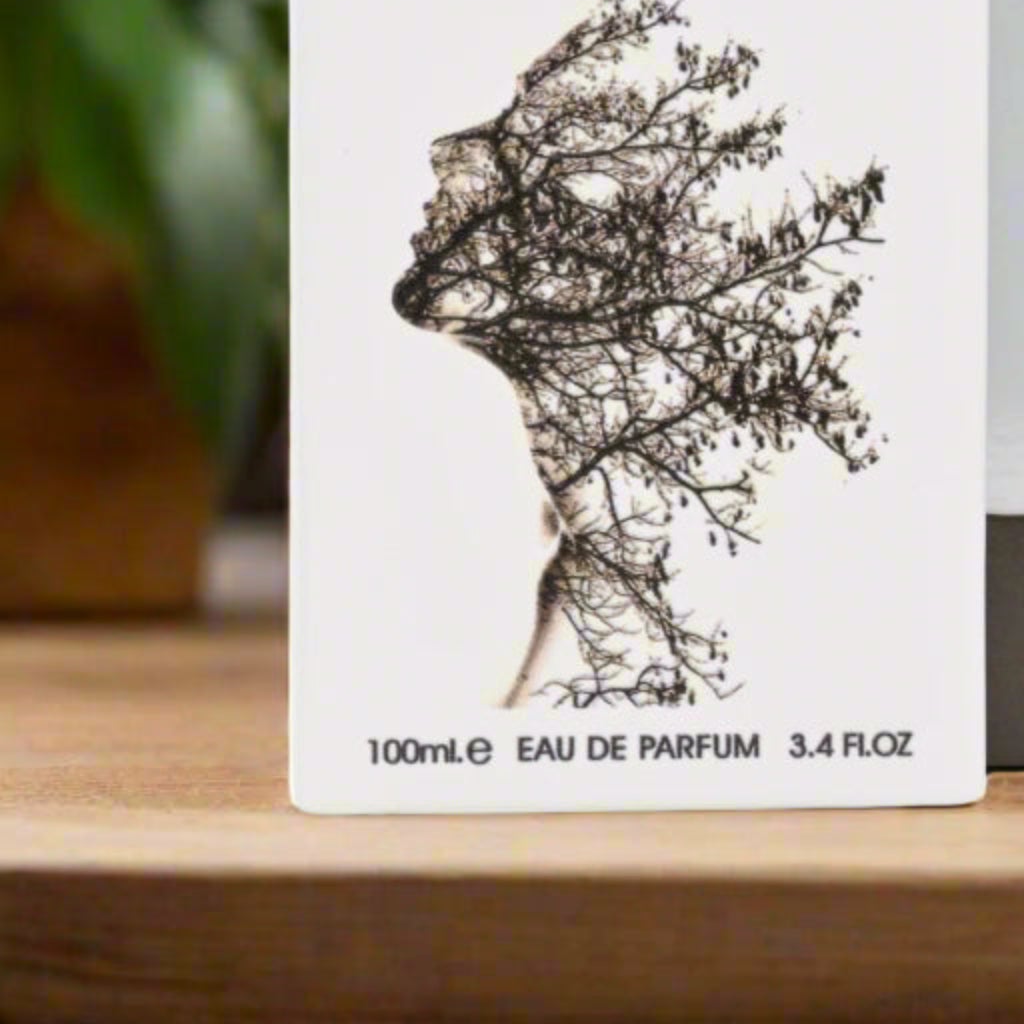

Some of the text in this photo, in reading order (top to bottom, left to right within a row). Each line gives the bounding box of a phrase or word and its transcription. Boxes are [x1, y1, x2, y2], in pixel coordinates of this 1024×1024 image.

[516, 735, 576, 763] EAU
[586, 734, 628, 762] DE
[638, 732, 761, 761] PARFUM
[788, 732, 836, 760] 3.4
